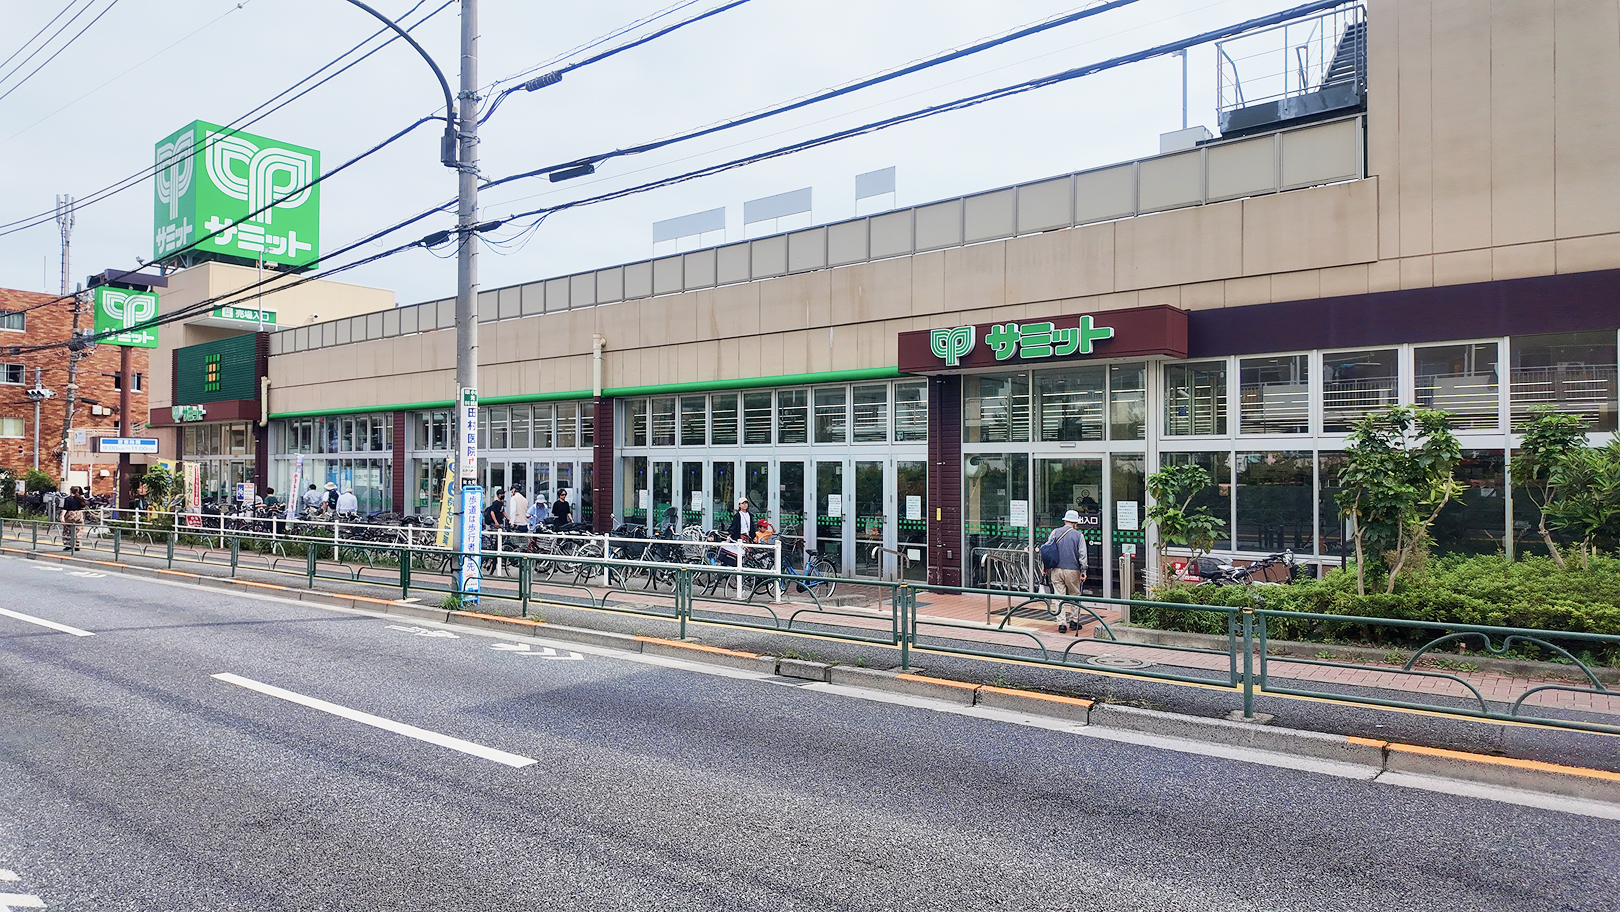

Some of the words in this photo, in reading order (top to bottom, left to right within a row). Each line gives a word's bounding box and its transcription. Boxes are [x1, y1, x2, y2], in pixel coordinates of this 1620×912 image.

[156, 216, 193, 255] サミット
[204, 215, 312, 258] サミット
[235, 309, 270, 321] 売場入口
[984, 315, 1115, 361] サミット
[182, 404, 207, 422] サミット
[467, 407, 476, 457] 田村医院
[466, 495, 477, 572] 歩道は歩行者先
